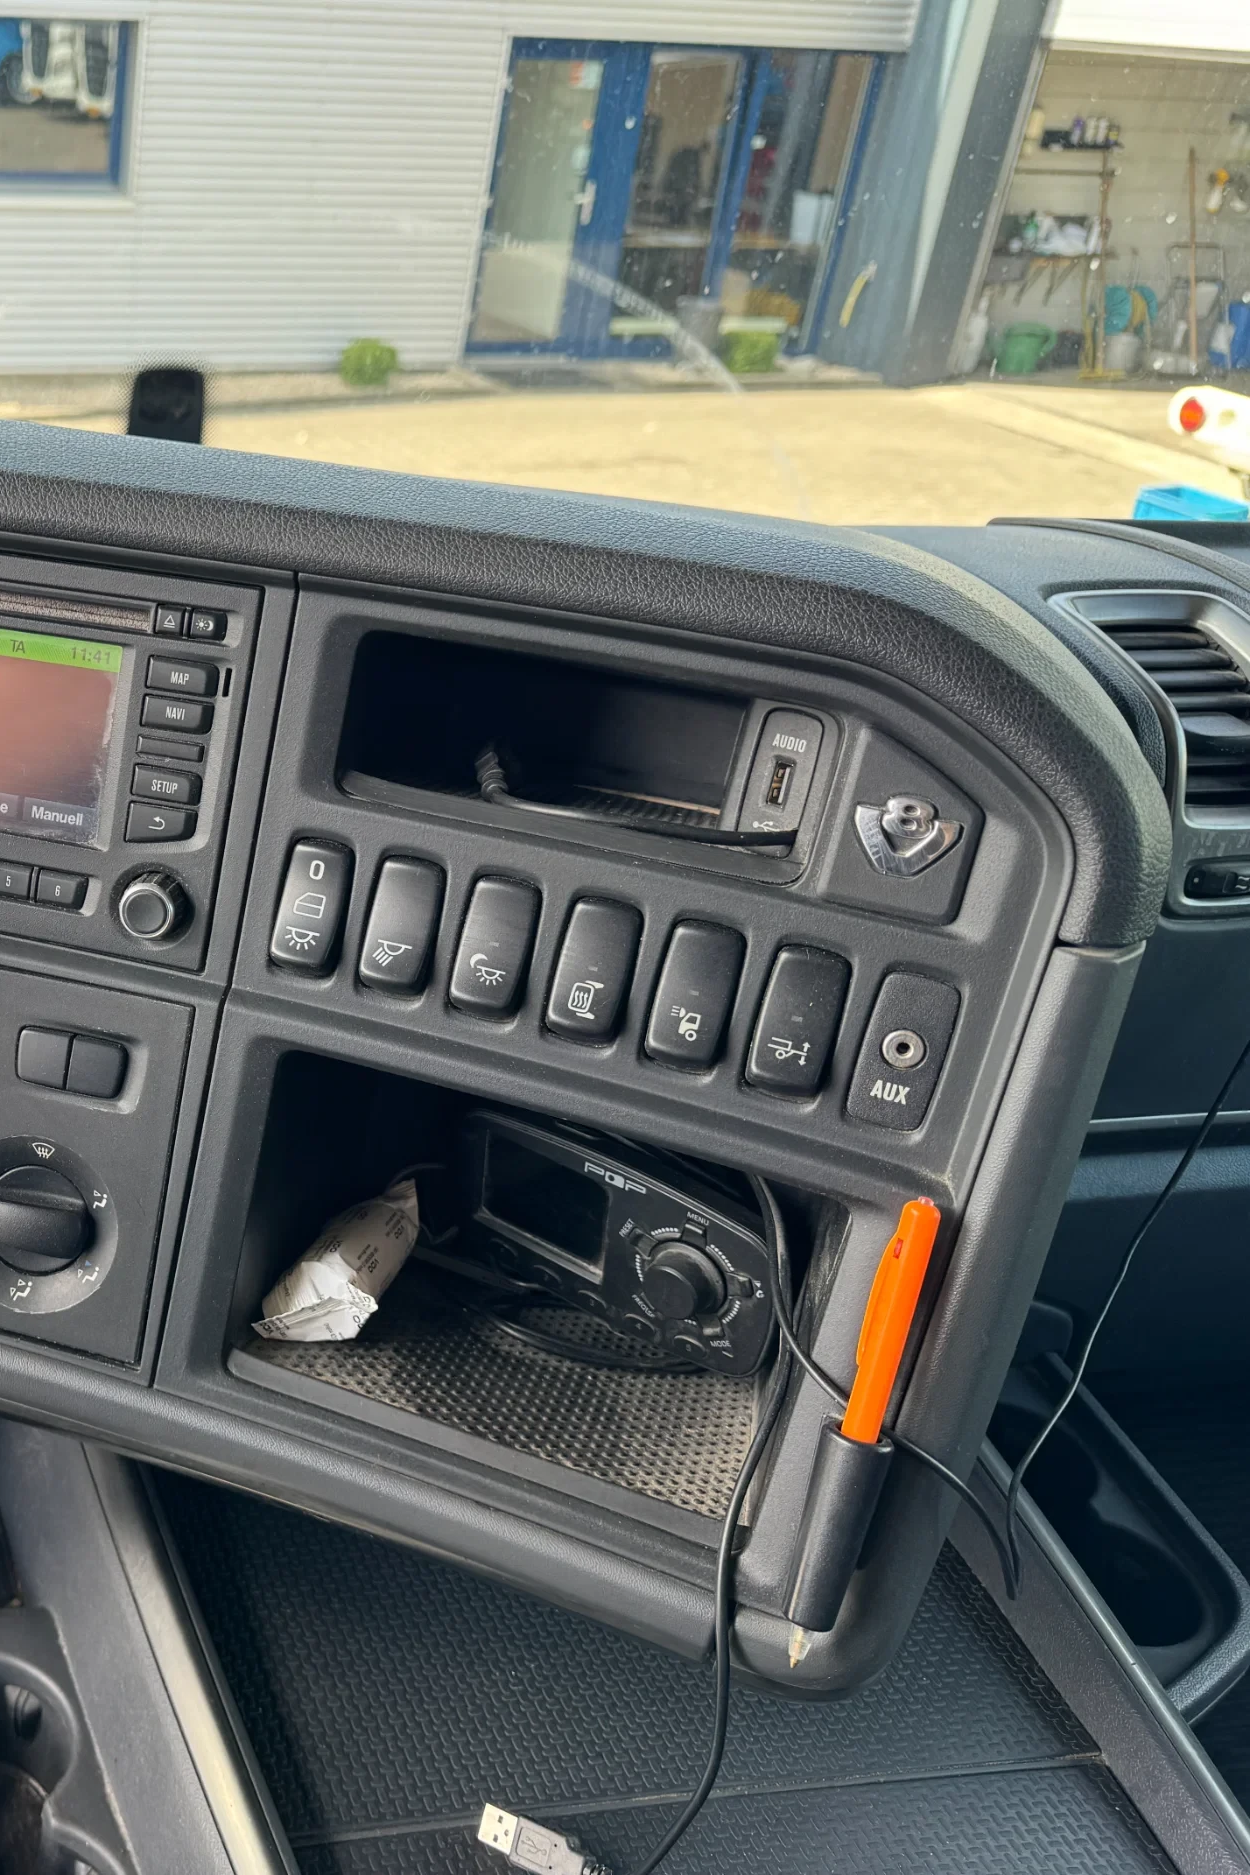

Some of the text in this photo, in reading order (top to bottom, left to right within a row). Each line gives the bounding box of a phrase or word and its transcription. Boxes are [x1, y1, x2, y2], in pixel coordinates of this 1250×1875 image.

[10, 639, 26, 653] TA
[70, 646, 111, 665] 11:41
[170, 671, 190, 685] MAP
[165, 706, 185, 721] NAVI
[772, 733, 807, 753] AUDIO
[150, 779, 178, 794] SETUP
[31, 806, 83, 827] Manuell
[5, 875, 11, 888] 5
[54, 885, 61, 897] 6
[869, 1079, 911, 1105] AUX
[584, 1161, 646, 1194] POP
[687, 1211, 710, 1227] MENU
[618, 1218, 636, 1238] PRESET
[709, 1340, 732, 1349] MODE
